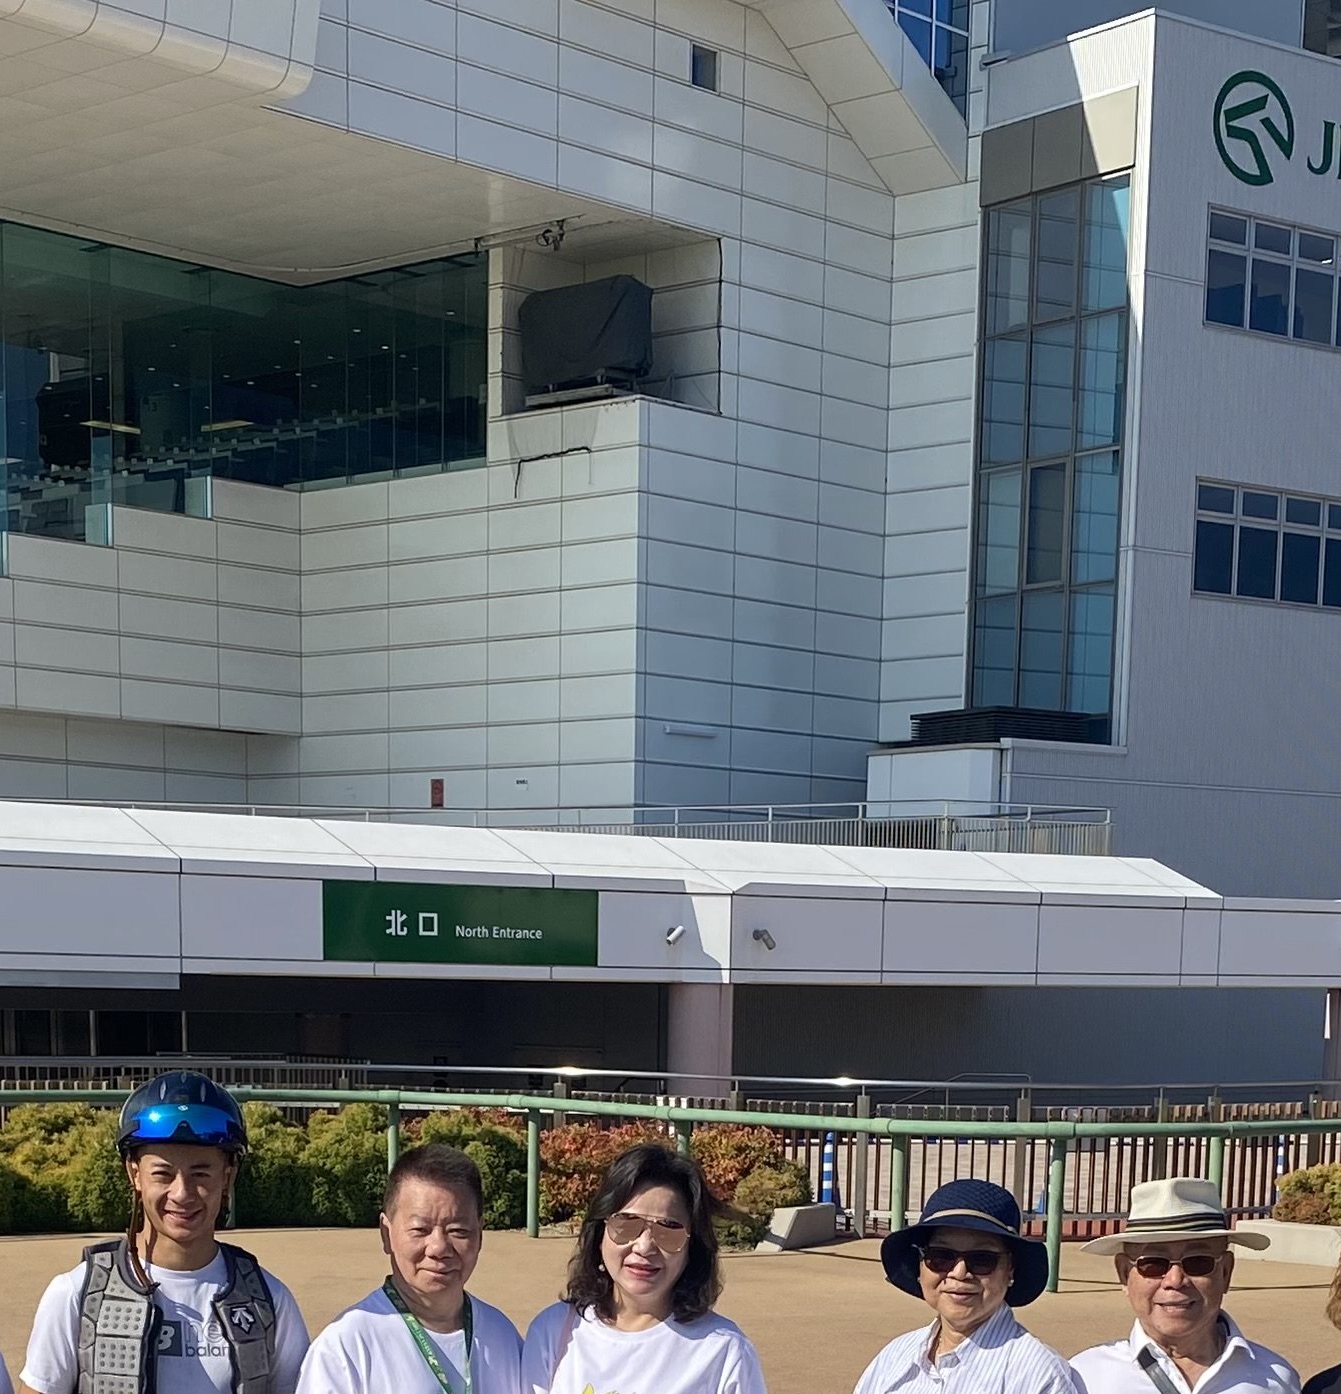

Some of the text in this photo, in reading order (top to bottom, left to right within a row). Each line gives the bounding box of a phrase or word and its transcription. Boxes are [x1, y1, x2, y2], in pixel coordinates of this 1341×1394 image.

[385, 909, 439, 937] 北口
[455, 924, 543, 941] North Entrance
[157, 1320, 224, 1351] B ne
